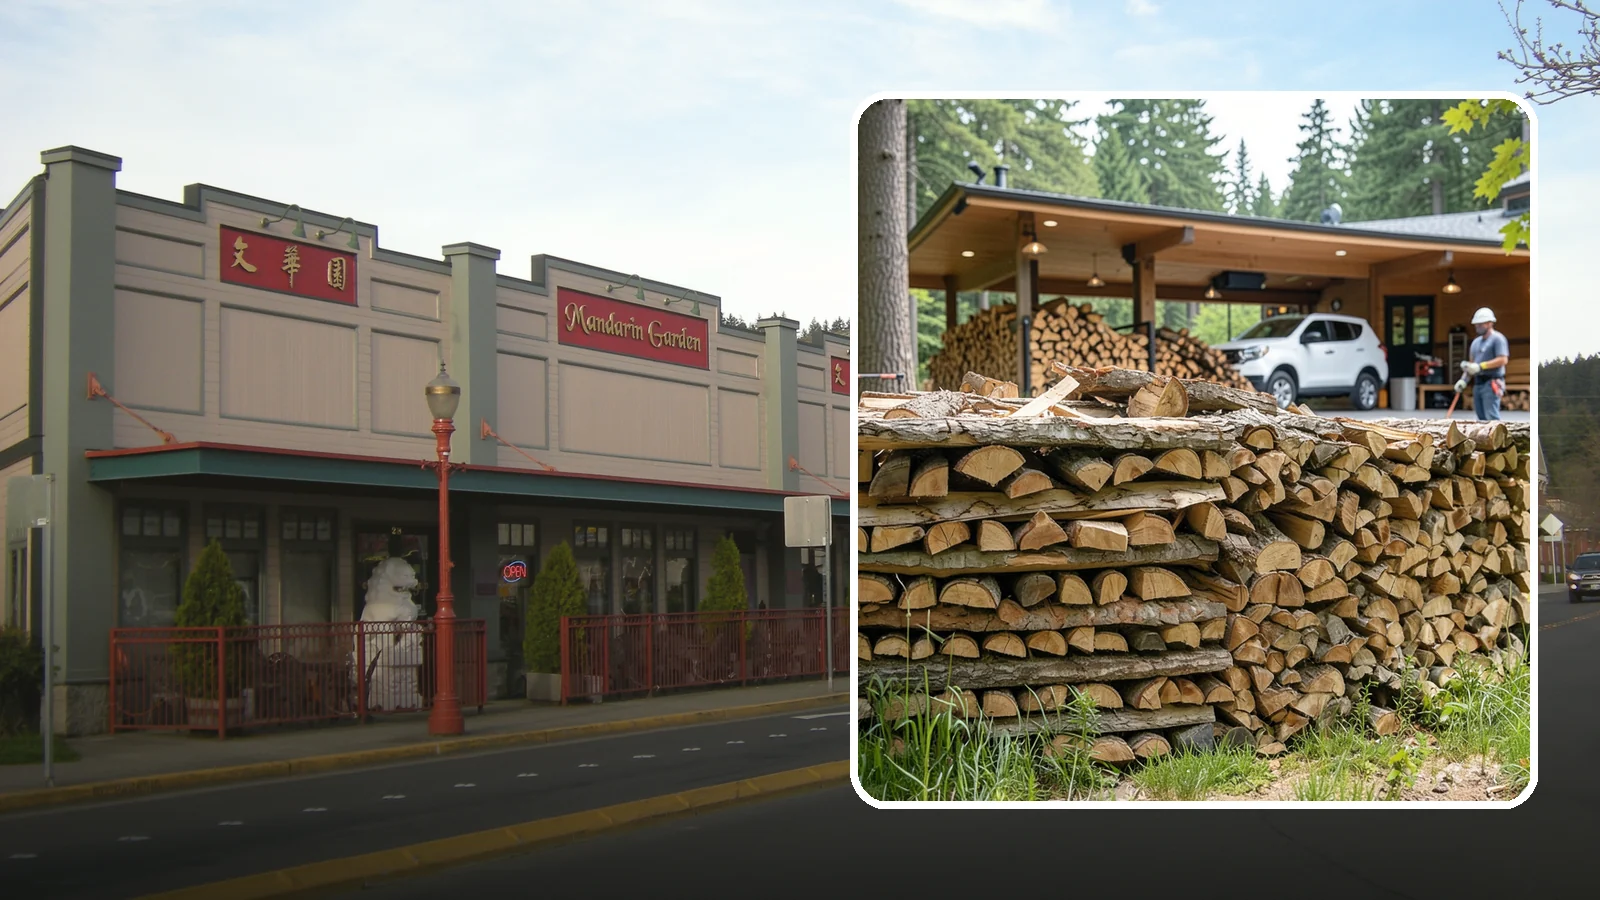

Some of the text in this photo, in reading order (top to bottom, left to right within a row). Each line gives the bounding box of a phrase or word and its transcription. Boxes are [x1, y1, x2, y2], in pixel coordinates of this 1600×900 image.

[230, 235, 346, 291] 文華園
[564, 302, 701, 352] Mandarin Garden
[503, 565, 527, 578] OPEN
